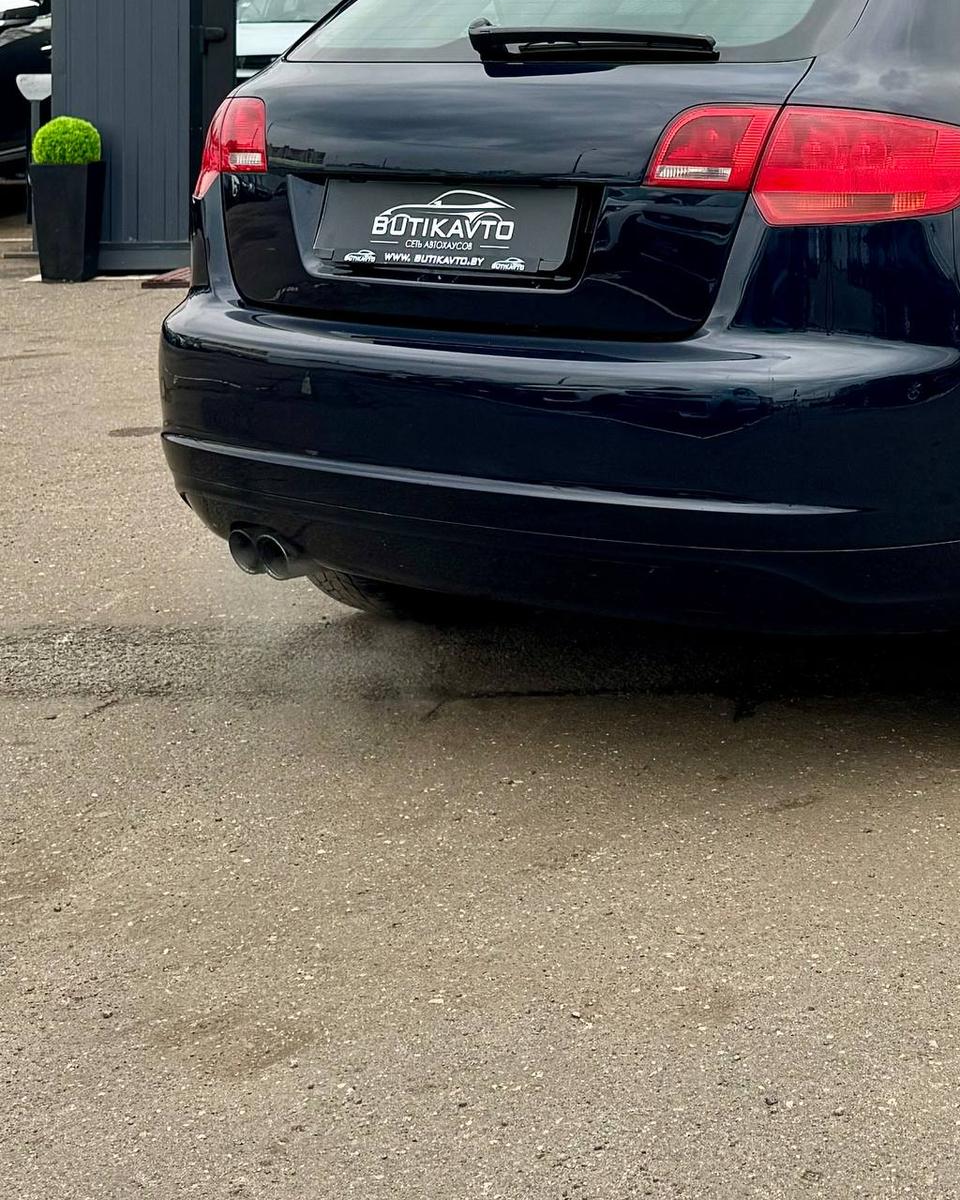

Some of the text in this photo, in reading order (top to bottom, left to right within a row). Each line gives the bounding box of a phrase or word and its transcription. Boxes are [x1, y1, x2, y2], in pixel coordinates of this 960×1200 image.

[371, 215, 515, 241] BUTIKAVTO
[405, 240, 473, 250] СЕТЬ АВТОХАУСОВ
[384, 252, 485, 266] WWW. BUTIKAVTO.BY
